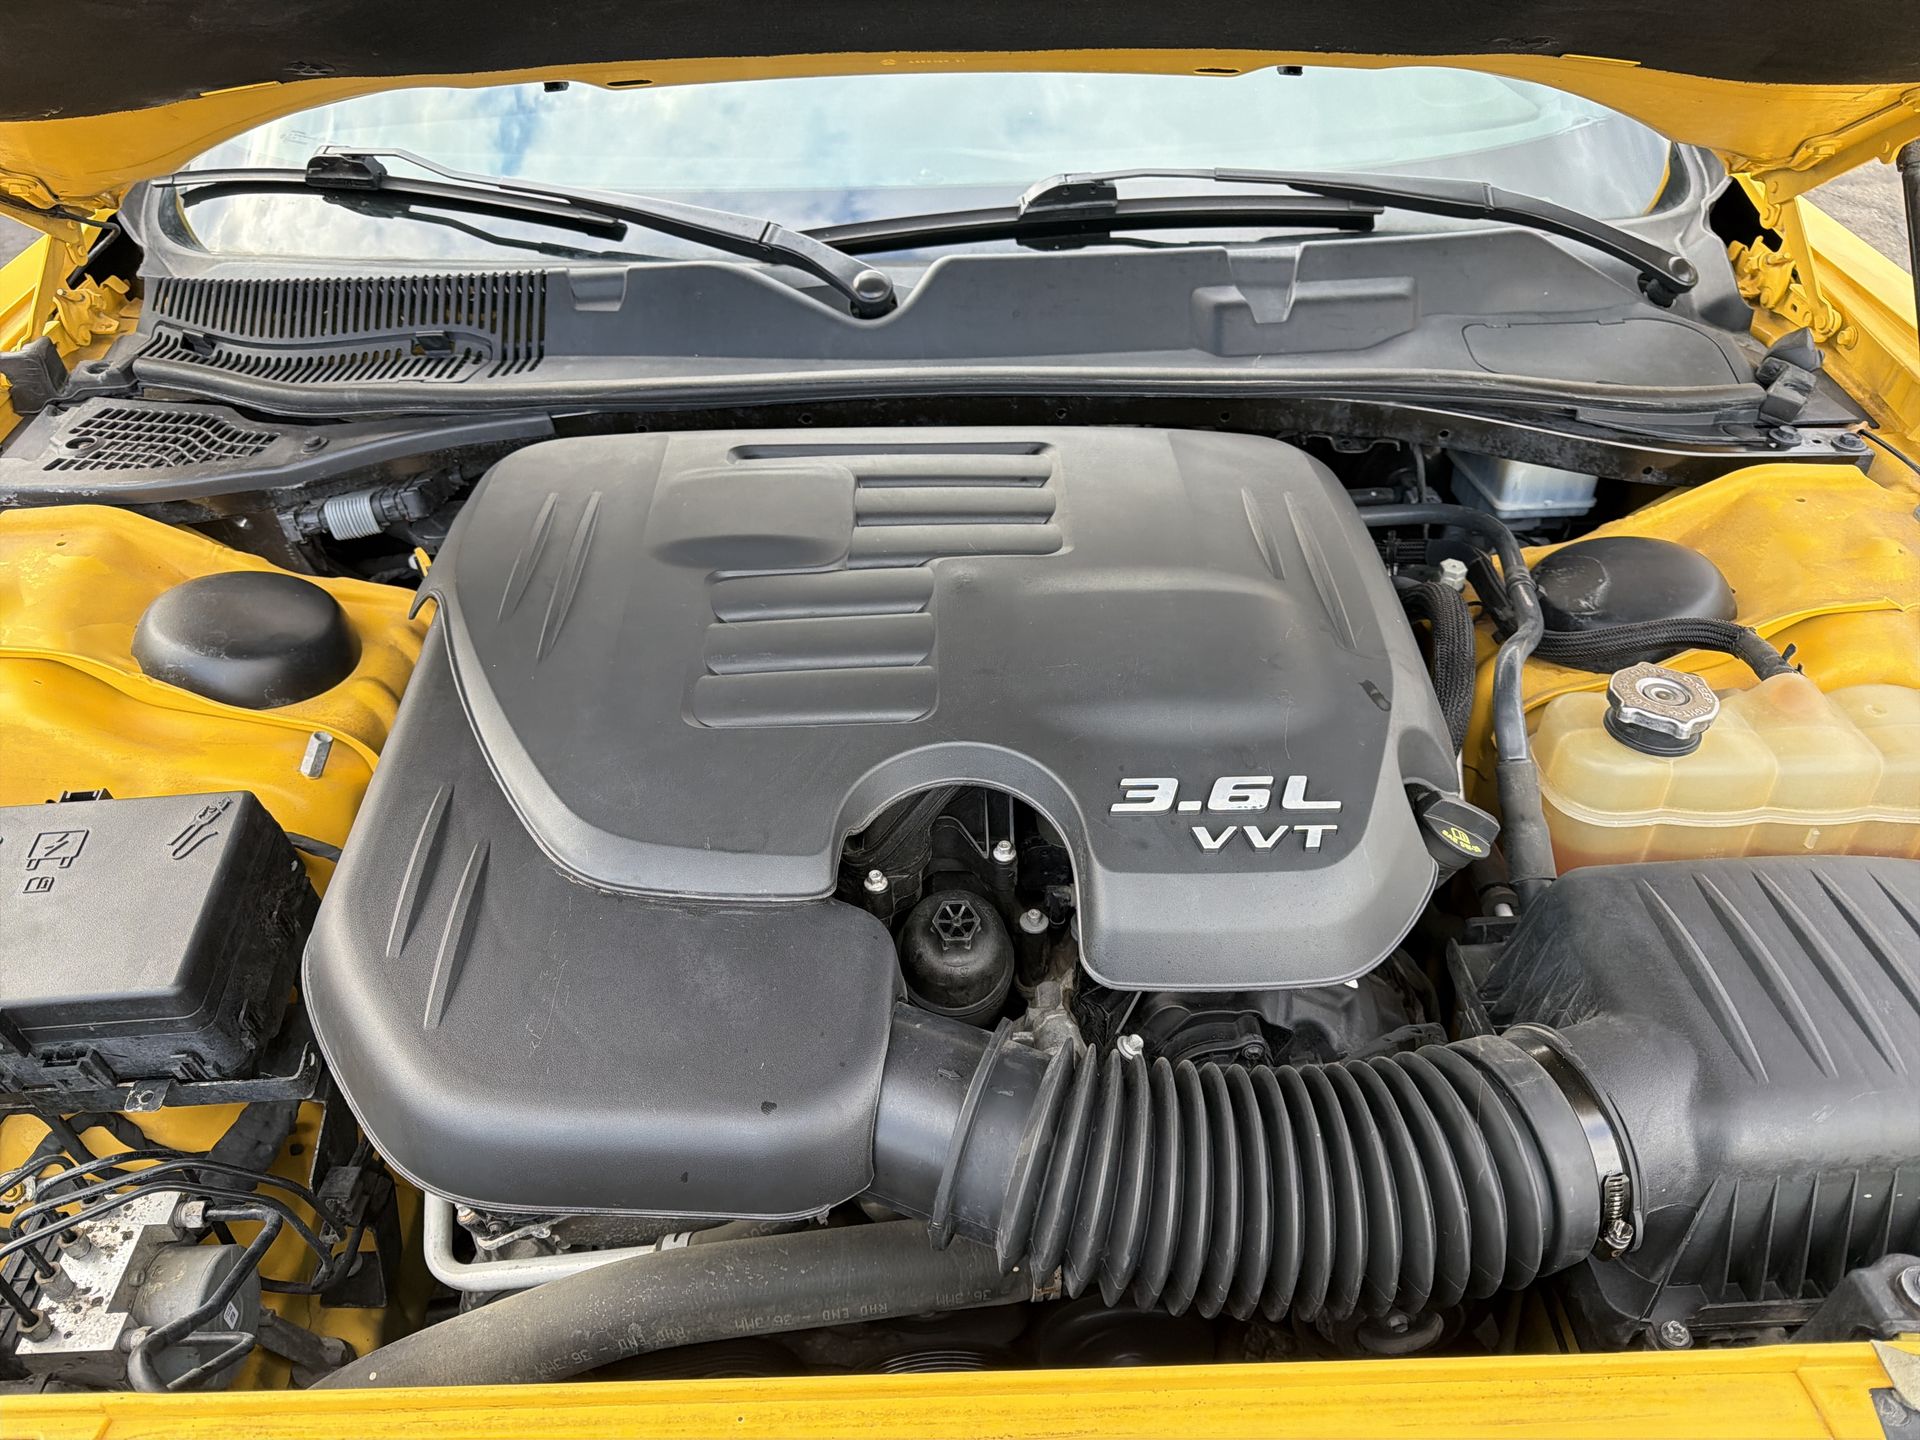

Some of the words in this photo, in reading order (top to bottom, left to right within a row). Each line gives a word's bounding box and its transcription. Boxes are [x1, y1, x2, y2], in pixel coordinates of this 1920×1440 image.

[1109, 775, 1342, 815] 3.6L
[1190, 824, 1339, 853] VVT
[822, 1307, 850, 1321] END
[860, 1302, 888, 1315] RAD
